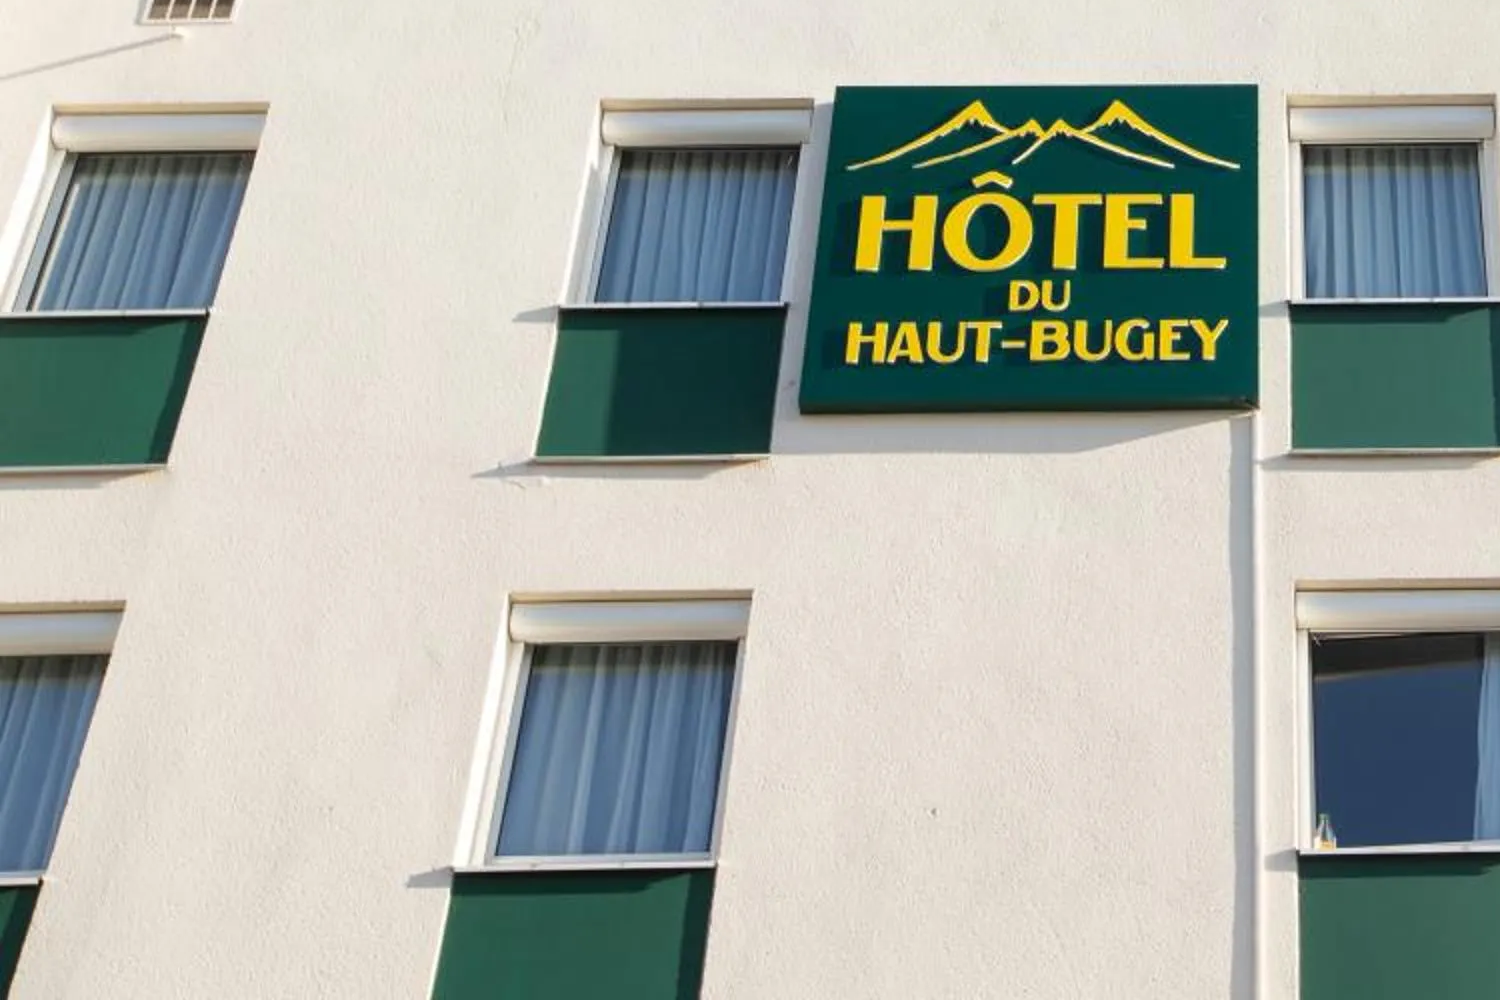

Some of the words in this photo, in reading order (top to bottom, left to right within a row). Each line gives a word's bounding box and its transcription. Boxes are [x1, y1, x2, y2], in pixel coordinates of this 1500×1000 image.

[855, 170, 1227, 272] HÔTEL
[1008, 279, 1071, 312] DU
[845, 318, 1229, 364] HAUT-BUGEY
